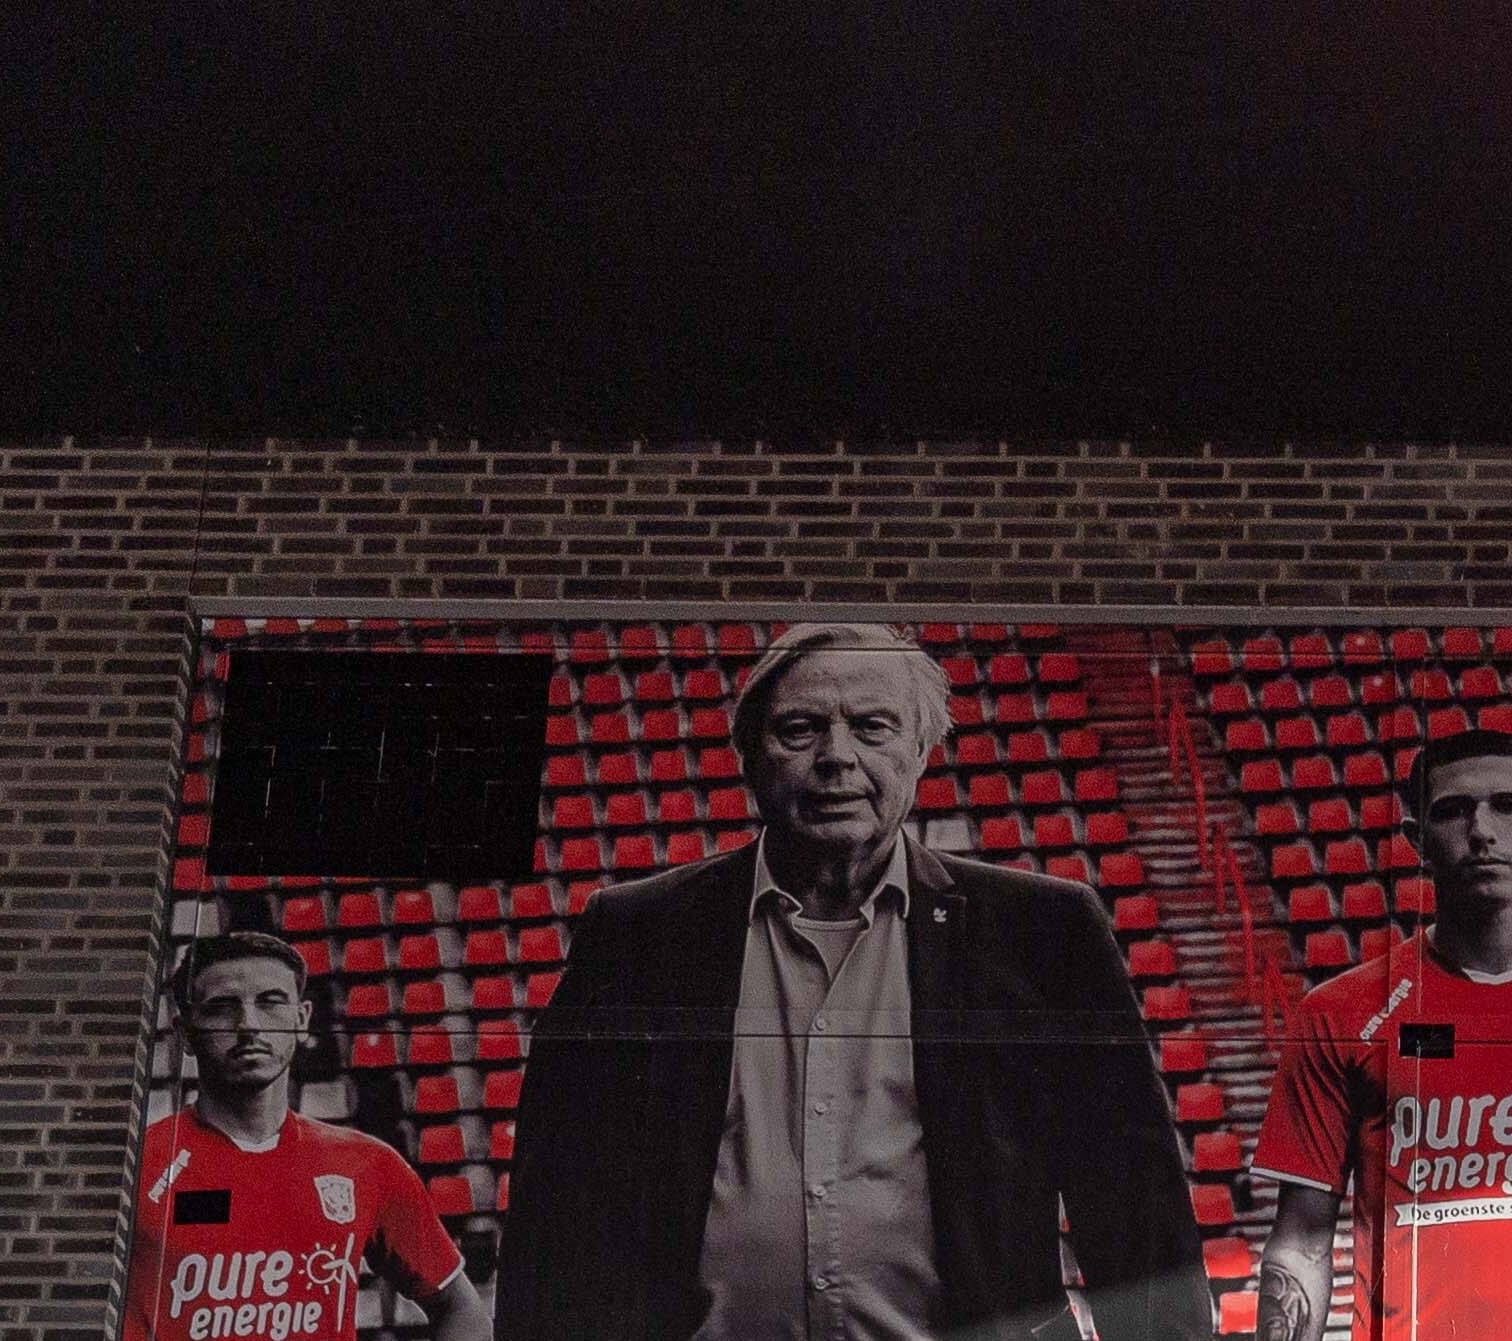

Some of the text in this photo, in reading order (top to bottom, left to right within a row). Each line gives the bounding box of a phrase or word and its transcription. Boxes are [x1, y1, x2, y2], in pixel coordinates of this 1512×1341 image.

[1433, 1203, 1506, 1222] groenste
[170, 1251, 293, 1319] pure
[190, 1301, 322, 1341] energie
